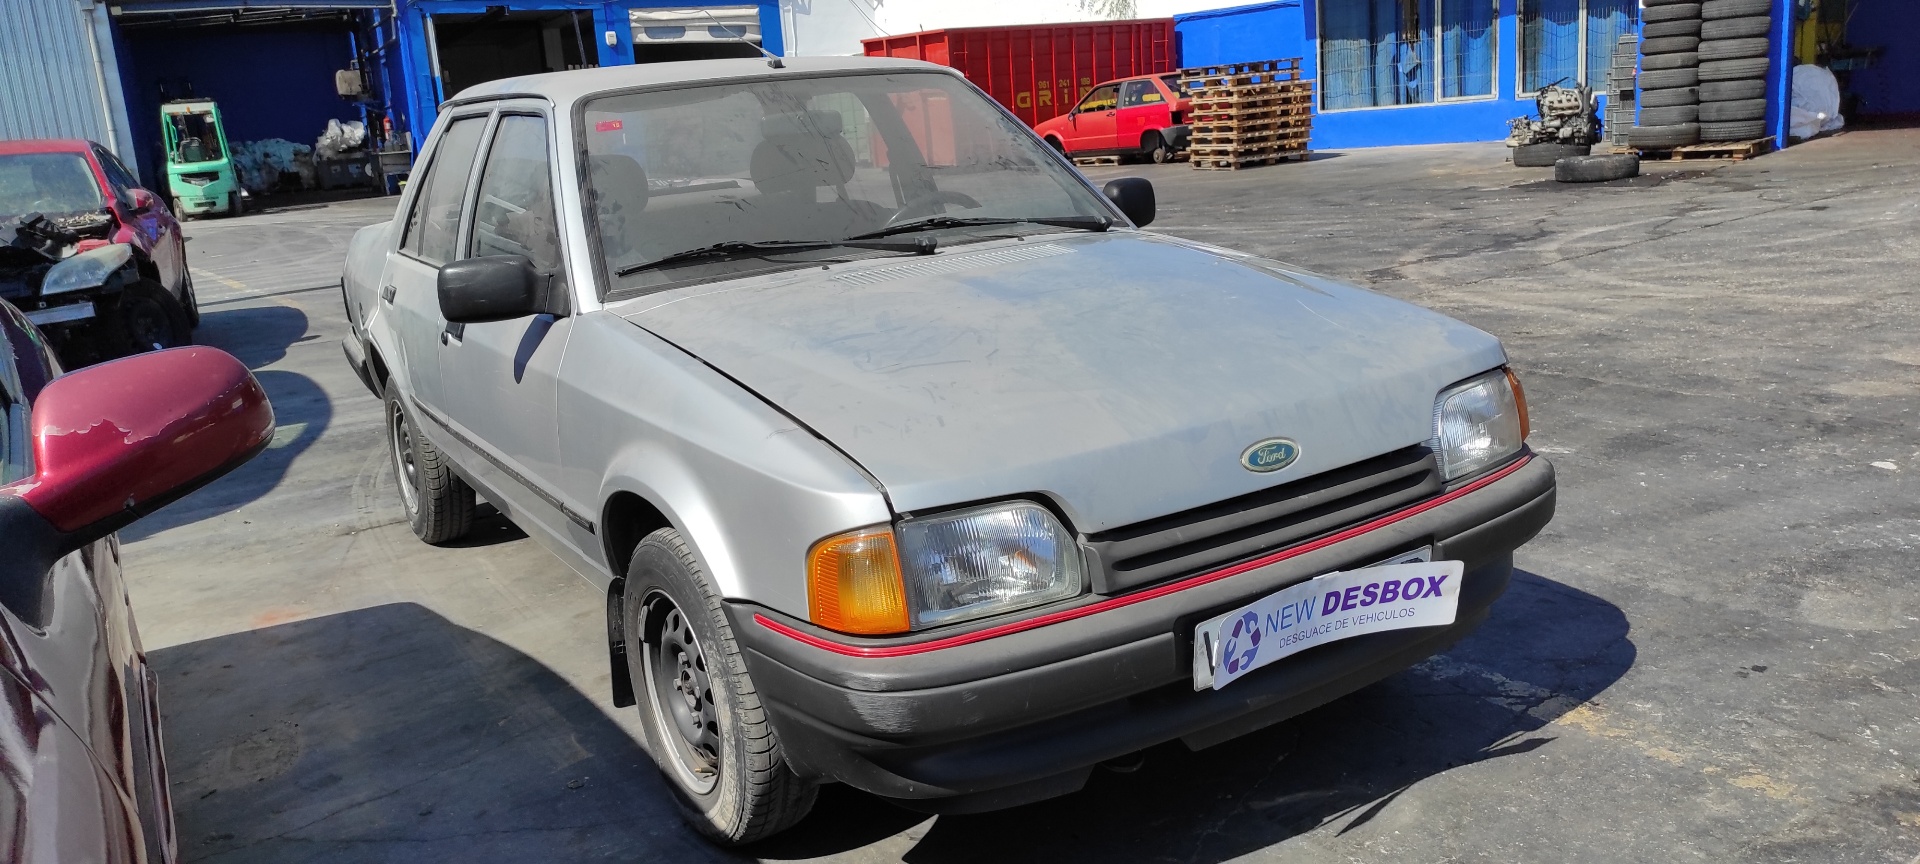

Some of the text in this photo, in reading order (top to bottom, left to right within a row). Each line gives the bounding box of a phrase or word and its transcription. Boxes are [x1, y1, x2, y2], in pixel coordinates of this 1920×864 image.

[1257, 445, 1286, 465] Ford
[1265, 575, 1449, 638] NEW DESBOX
[1279, 607, 1416, 649] DESGUACE DE VEHICULOS
